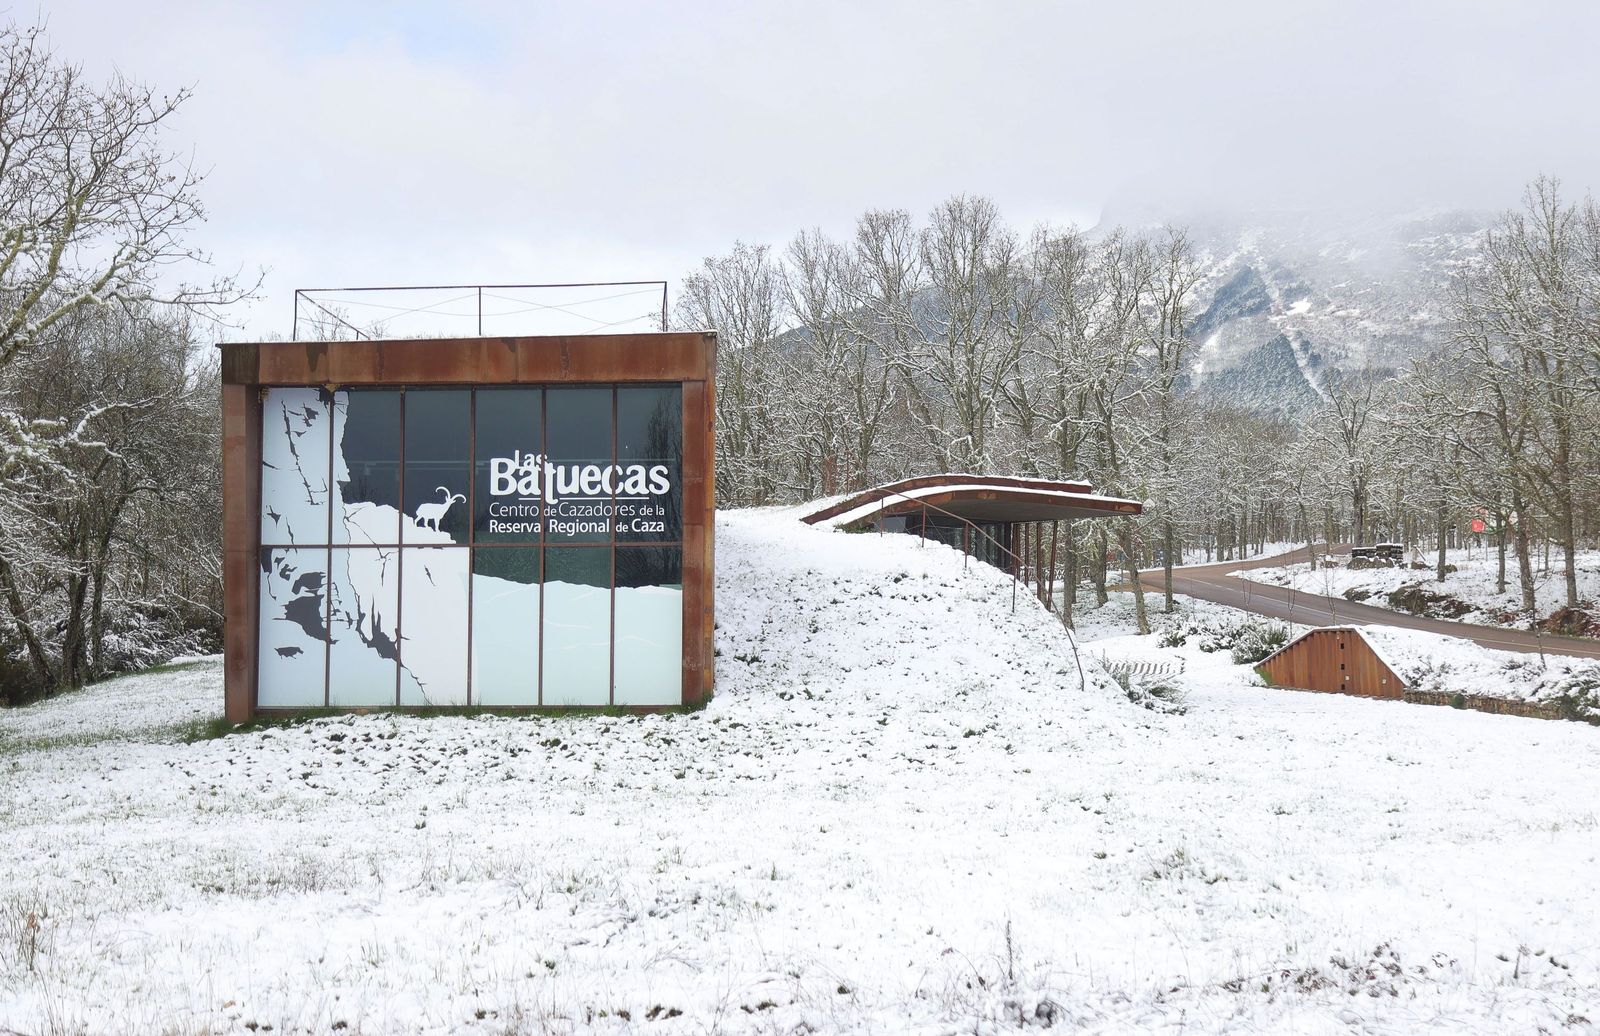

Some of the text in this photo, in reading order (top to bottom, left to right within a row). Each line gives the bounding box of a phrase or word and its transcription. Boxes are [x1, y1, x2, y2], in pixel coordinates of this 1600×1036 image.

[515, 450, 547, 469] Las
[490, 458, 670, 504] Batuecas
[489, 502, 665, 517] Centro de Cazadores de la
[489, 519, 665, 536] Reserva Regional de Caza
